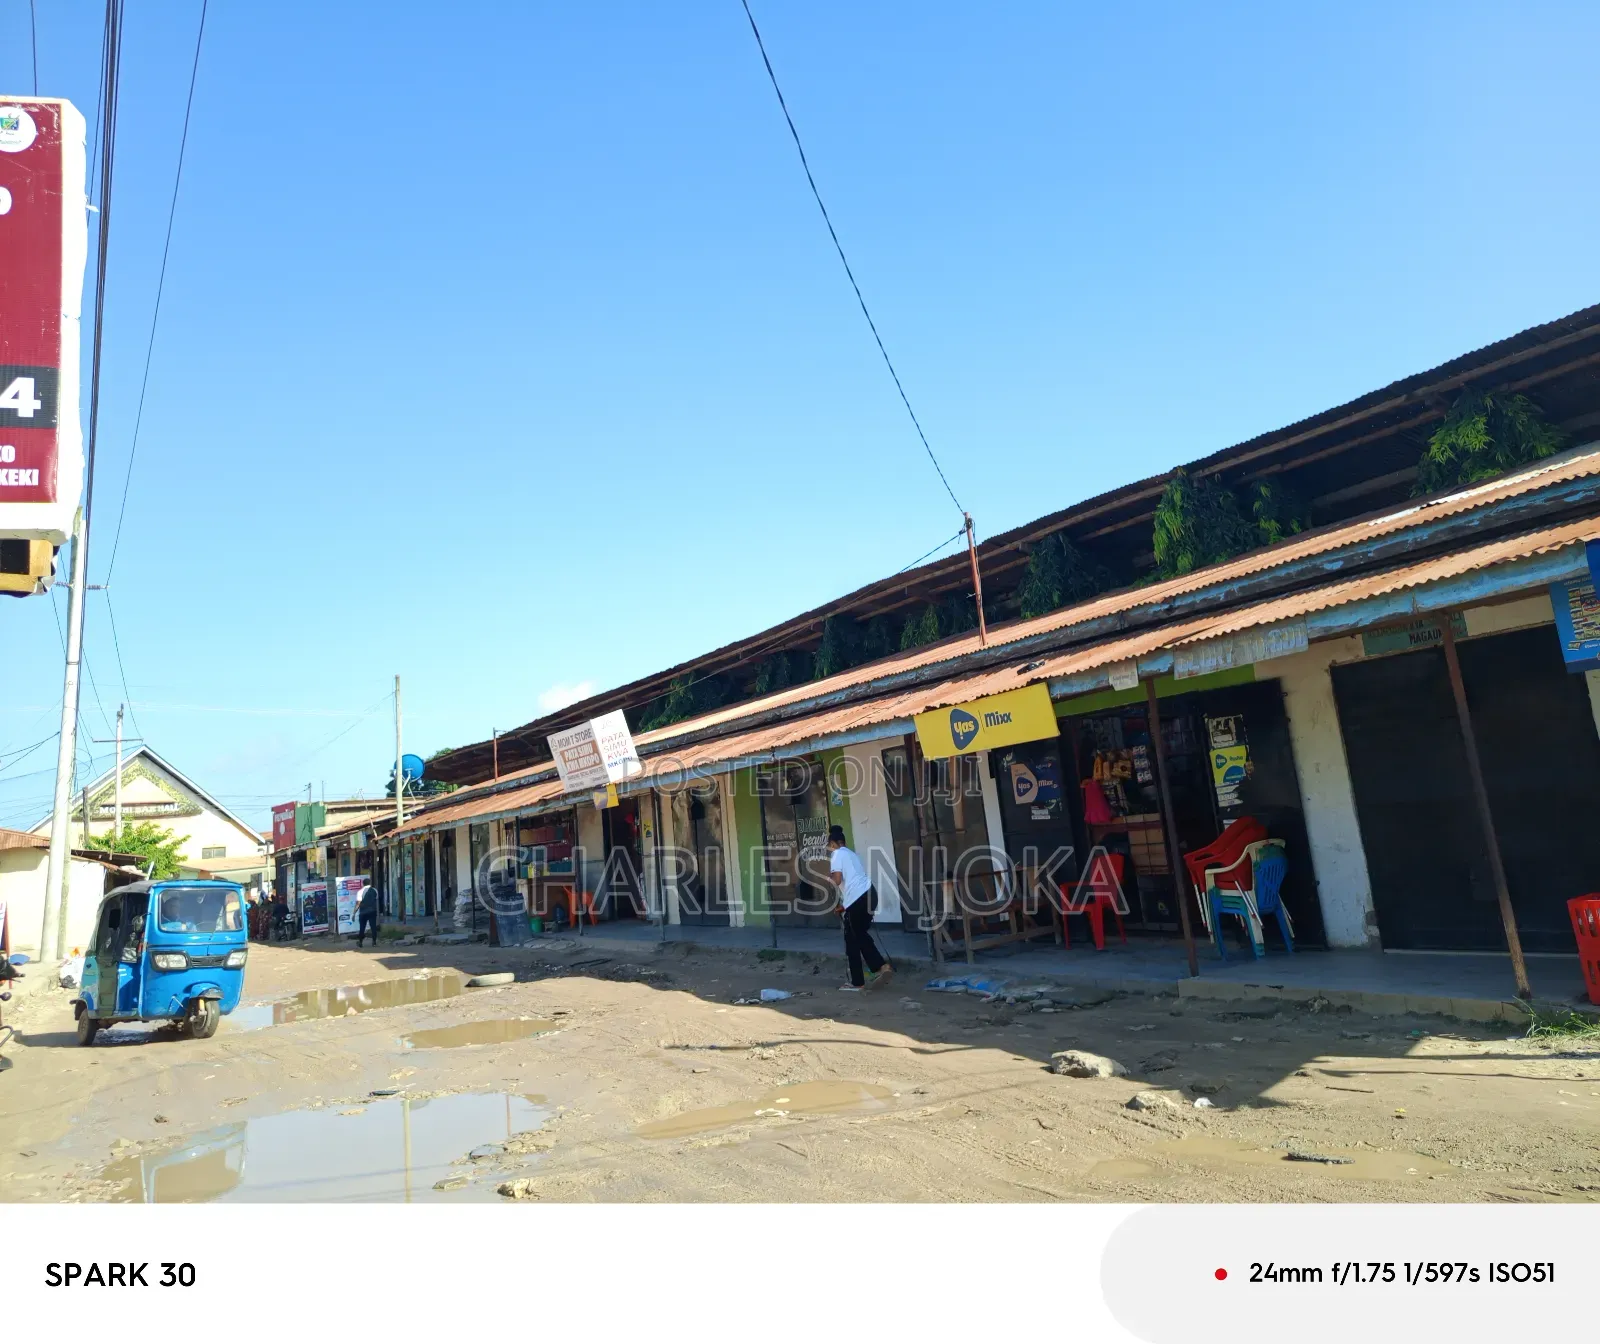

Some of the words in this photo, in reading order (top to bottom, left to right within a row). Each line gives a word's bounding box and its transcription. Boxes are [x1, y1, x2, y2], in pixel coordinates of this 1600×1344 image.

[953, 720, 975, 740] yas
[984, 711, 1013, 728] Mixx
[574, 728, 593, 743] STORE
[602, 732, 624, 744] PATA
[603, 740, 627, 754] SIMU
[607, 747, 629, 760] KWA
[607, 756, 633, 769] MKOPO
[99, 805, 132, 814] MOHI
[802, 832, 829, 848] beauty
